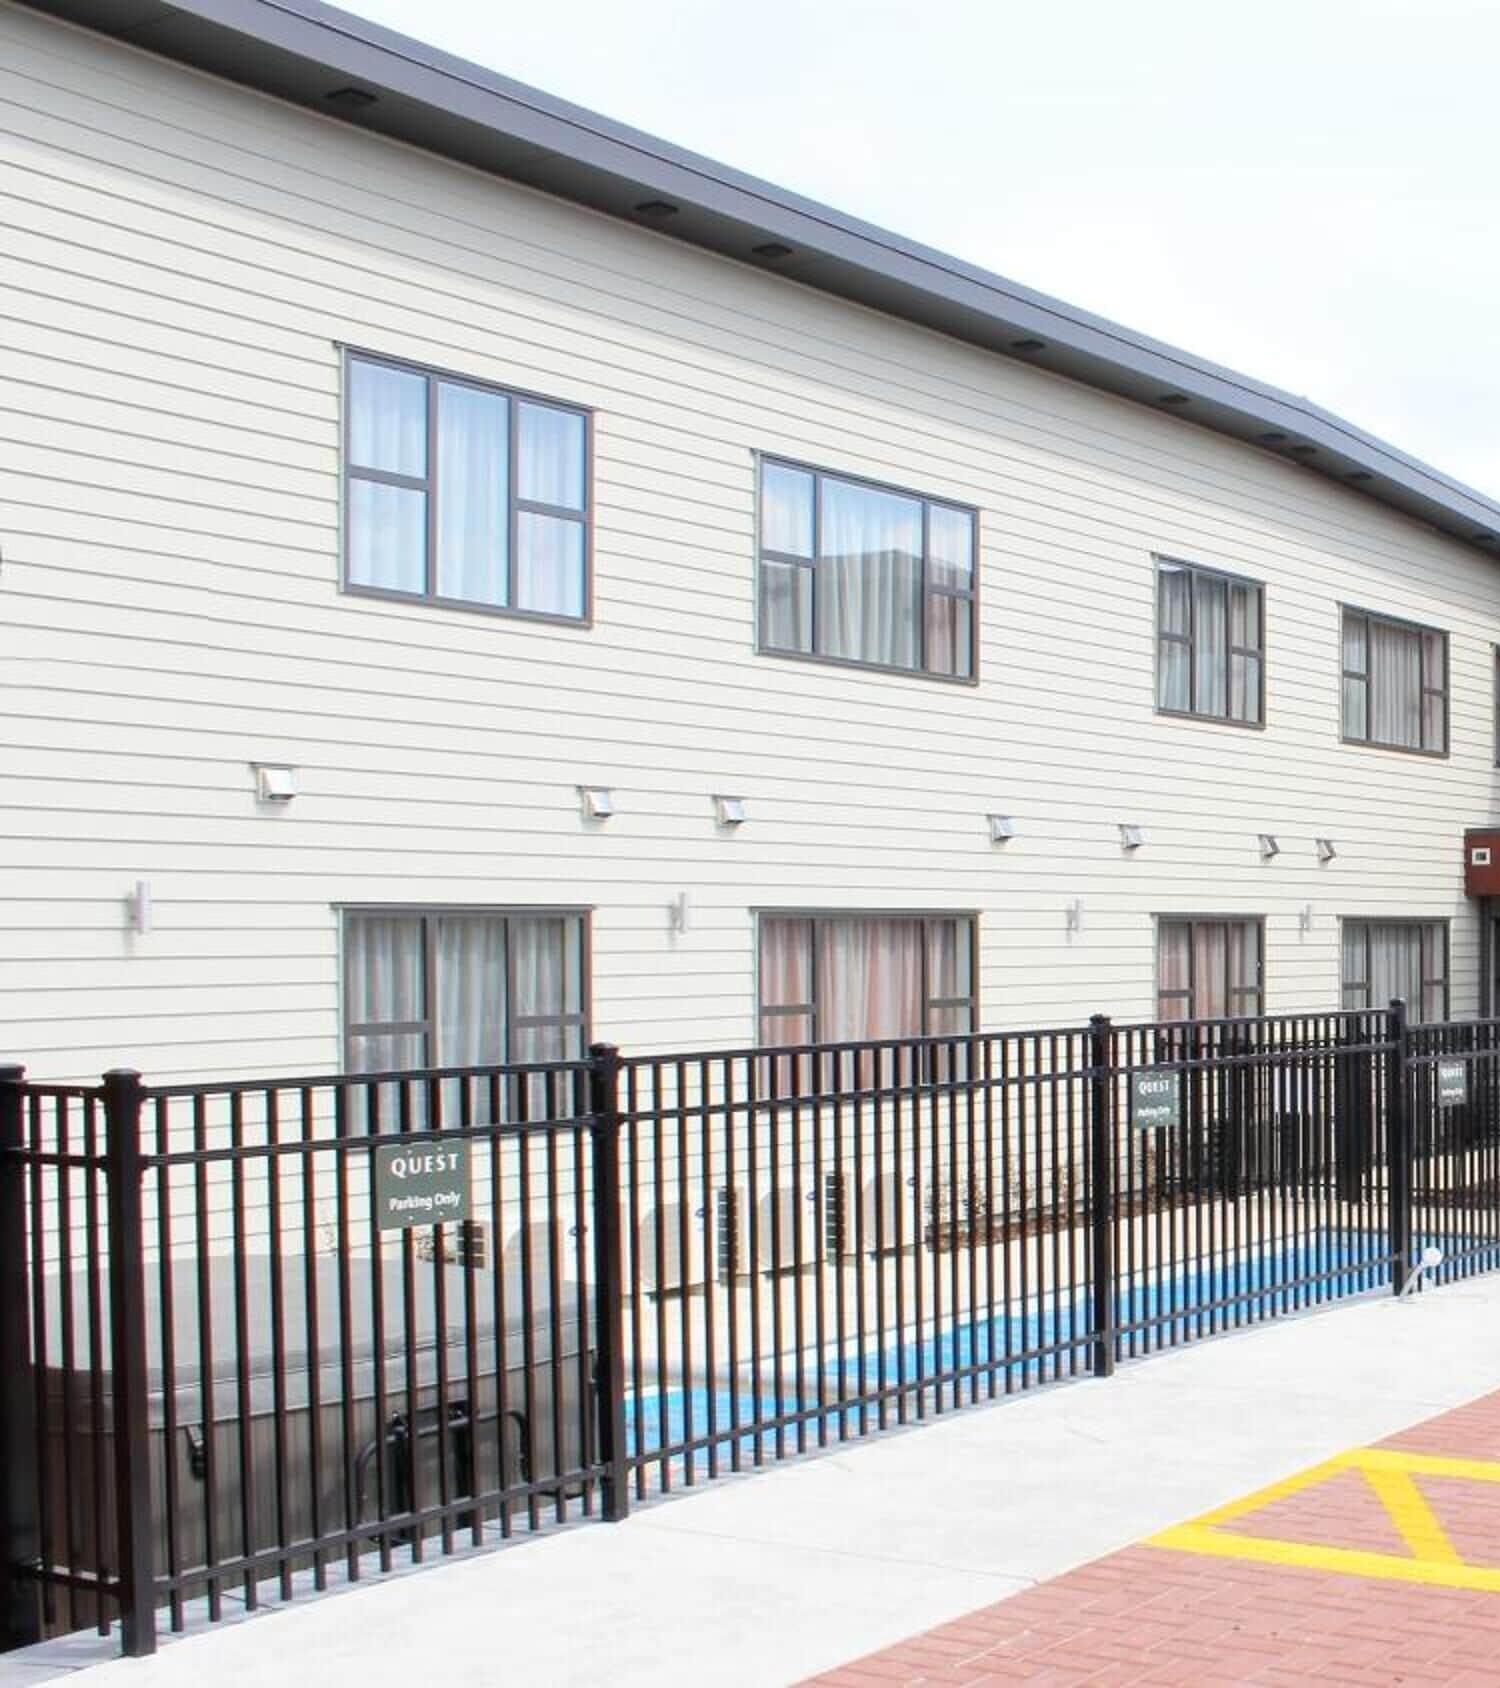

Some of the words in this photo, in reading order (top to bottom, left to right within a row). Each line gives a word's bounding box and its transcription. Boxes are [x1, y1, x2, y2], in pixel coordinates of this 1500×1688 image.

[390, 1153, 459, 1178] QUEST
[389, 1195, 433, 1211] Parking
[434, 1191, 461, 1207] Only
